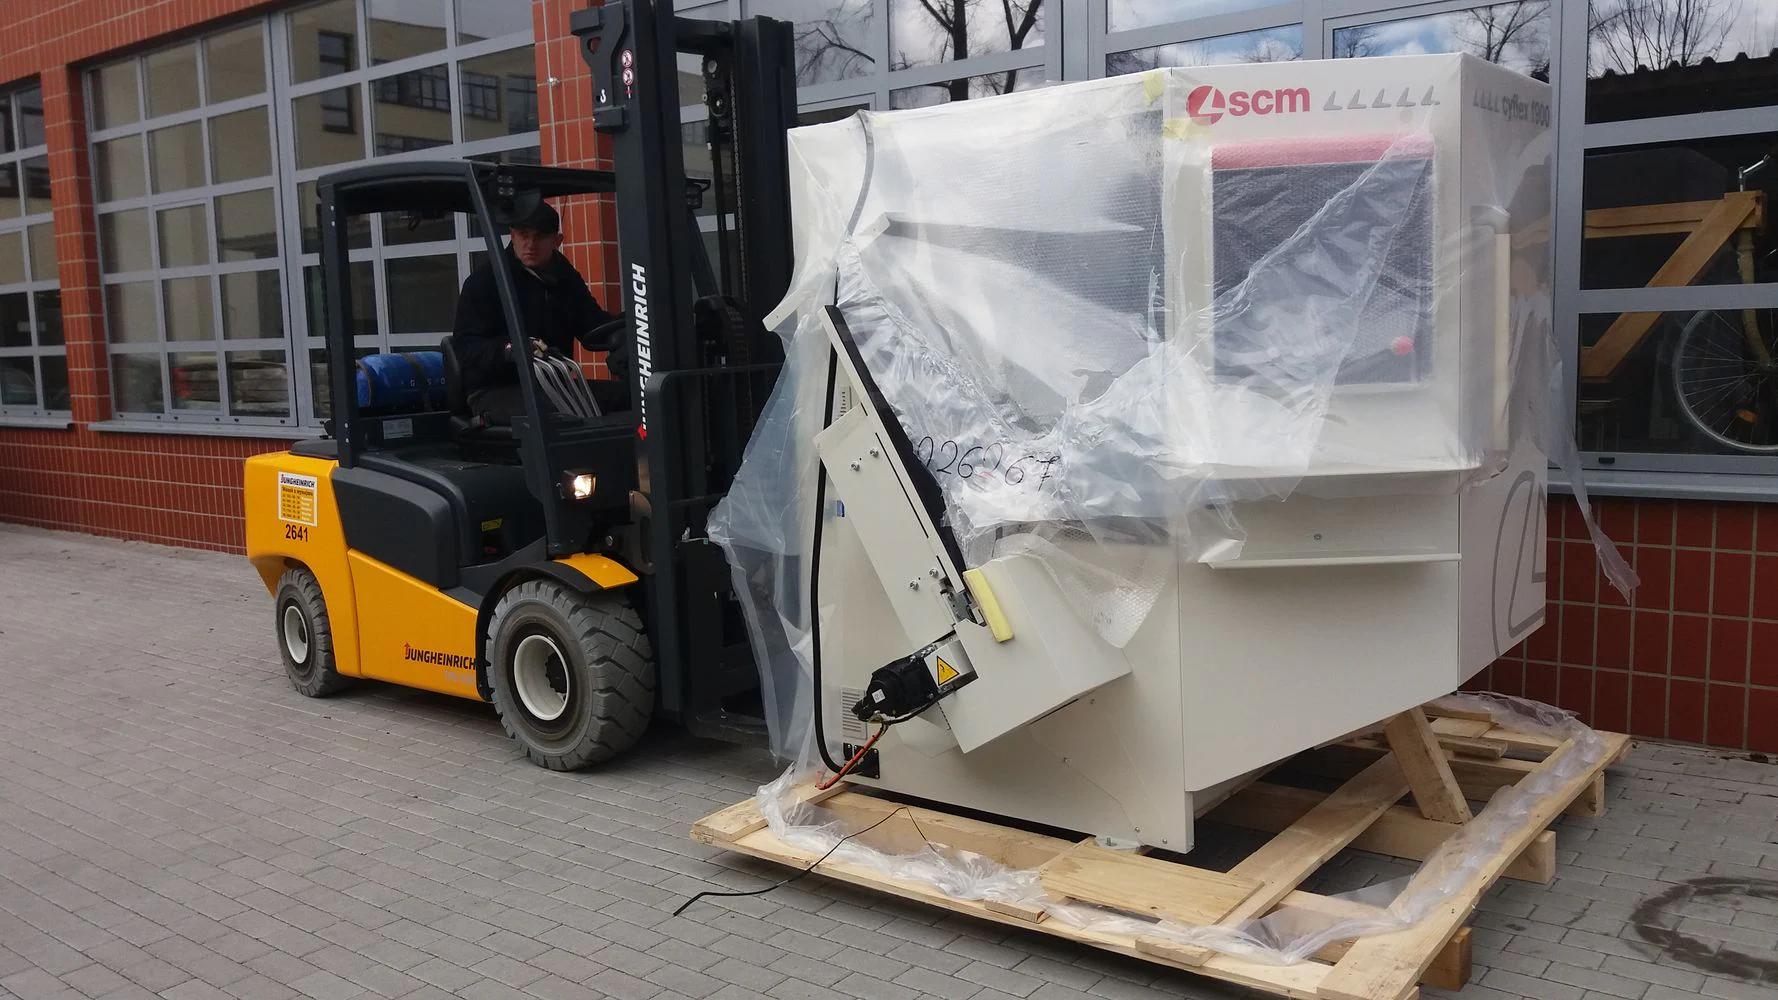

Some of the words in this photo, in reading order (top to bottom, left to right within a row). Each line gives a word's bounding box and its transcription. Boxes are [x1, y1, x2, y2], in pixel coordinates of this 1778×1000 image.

[1228, 87, 1311, 117] scm
[1502, 93, 1528, 121] cyflex
[1531, 100, 1550, 128] 1900
[280, 474, 316, 488] JUNGHEINRICH
[285, 523, 309, 543] 2641
[404, 642, 477, 671] JUNGHEINRICH
